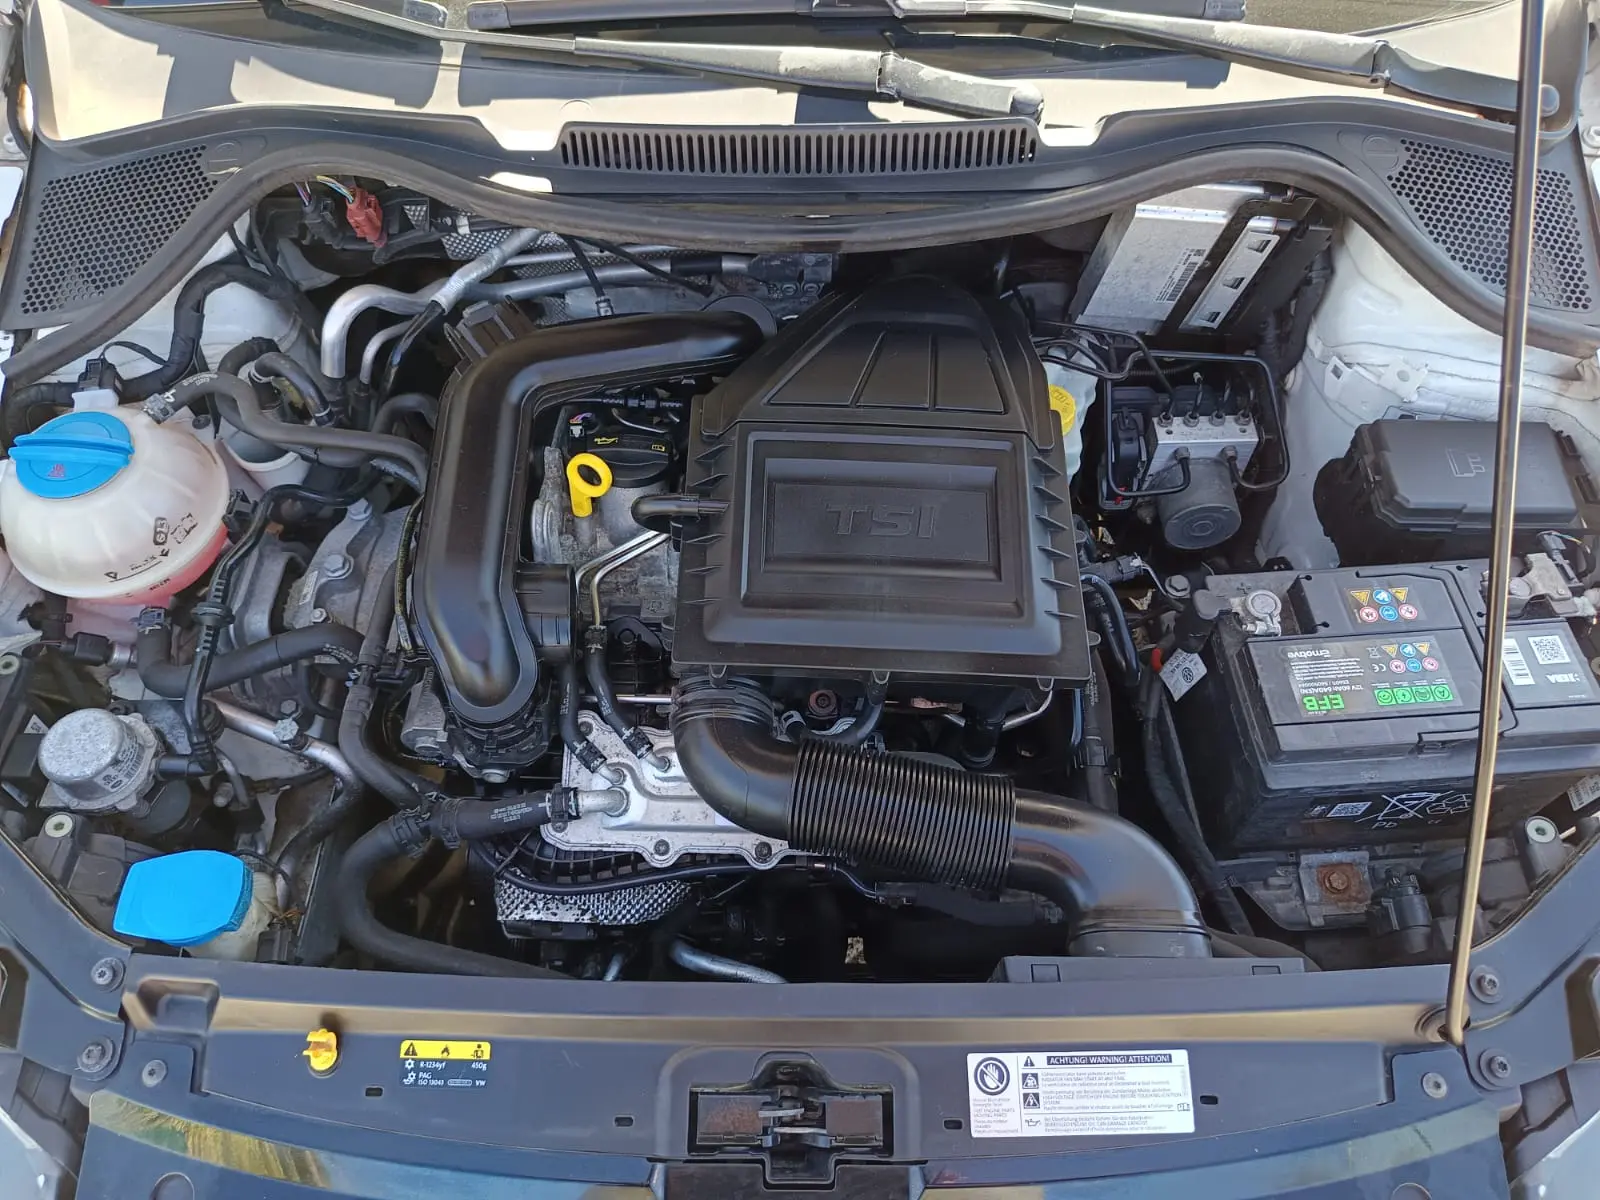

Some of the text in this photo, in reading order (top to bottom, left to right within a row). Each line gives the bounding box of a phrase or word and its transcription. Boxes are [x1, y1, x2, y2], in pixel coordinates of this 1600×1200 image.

[825, 503, 936, 539] TSI
[1302, 693, 1345, 711] EFB
[1049, 1054, 1170, 1065] ACHTUNG! WARNING! ATTENTION!
[418, 1071, 432, 1079] PAG
